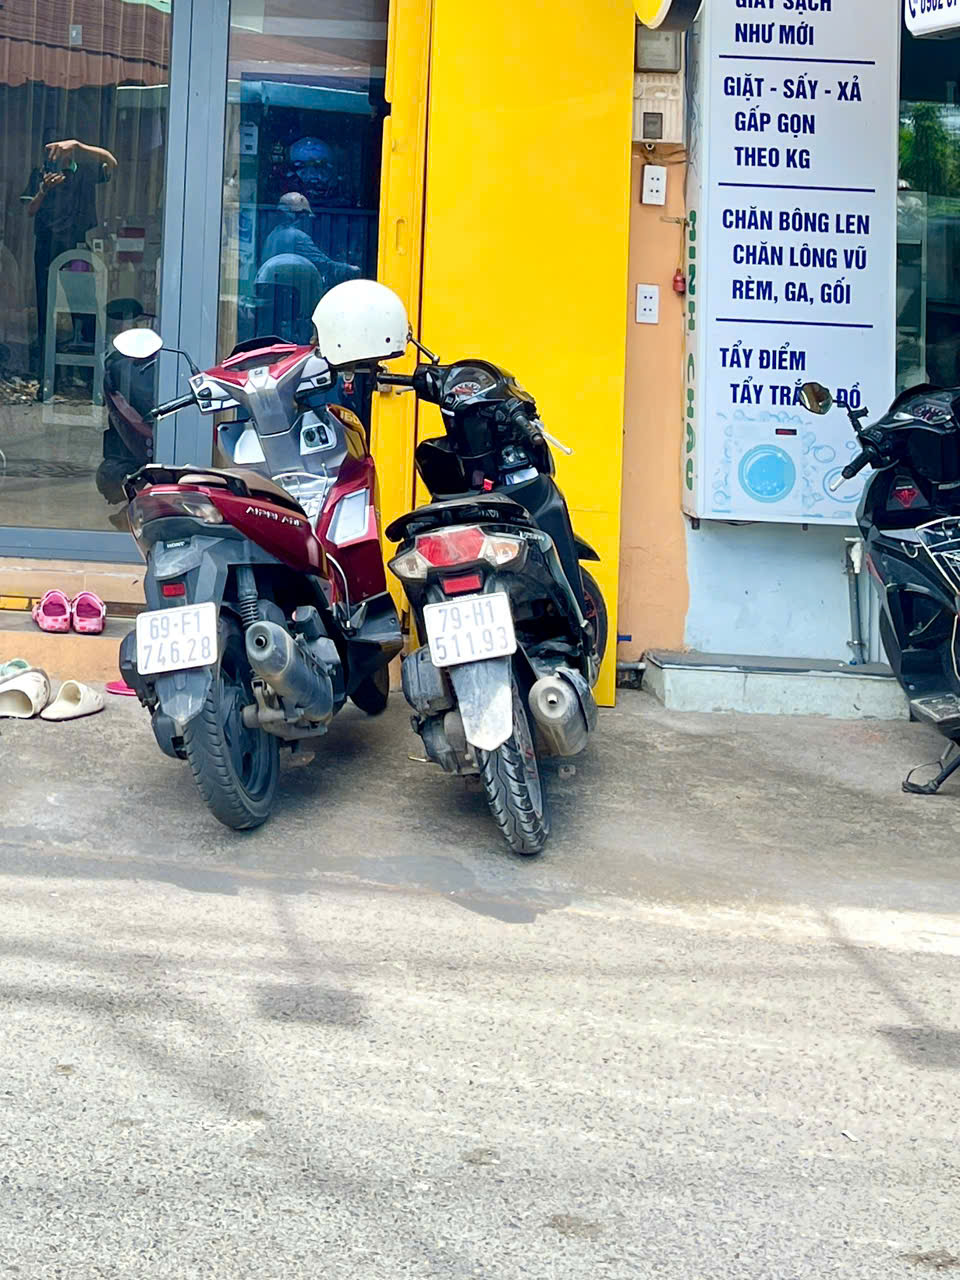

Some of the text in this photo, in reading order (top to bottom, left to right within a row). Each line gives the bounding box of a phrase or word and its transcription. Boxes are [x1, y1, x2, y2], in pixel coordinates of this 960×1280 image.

[735, 21, 814, 46] NHƯ MỚI
[723, 73, 764, 101] GIẶT
[783, 73, 818, 100] SẤY
[837, 75, 862, 102] XẢ
[734, 105, 815, 138] GẤP GỌN
[734, 146, 811, 169] THEO KG
[722, 205, 870, 235] CHĂN BÔNG LEN
[732, 241, 868, 270] CHĂN LÔNG VŨ
[732, 275, 851, 306] RÈM, GA, GỐI
[719, 339, 806, 371] TẨY ĐIỂM
[730, 375, 764, 404] TẨY
[769, 378, 806, 406] TRẮ
[149, 610, 201, 641] 69-F1
[438, 600, 496, 633] 79-H1
[142, 635, 212, 671] 746.28
[434, 625, 509, 661] 511.93
